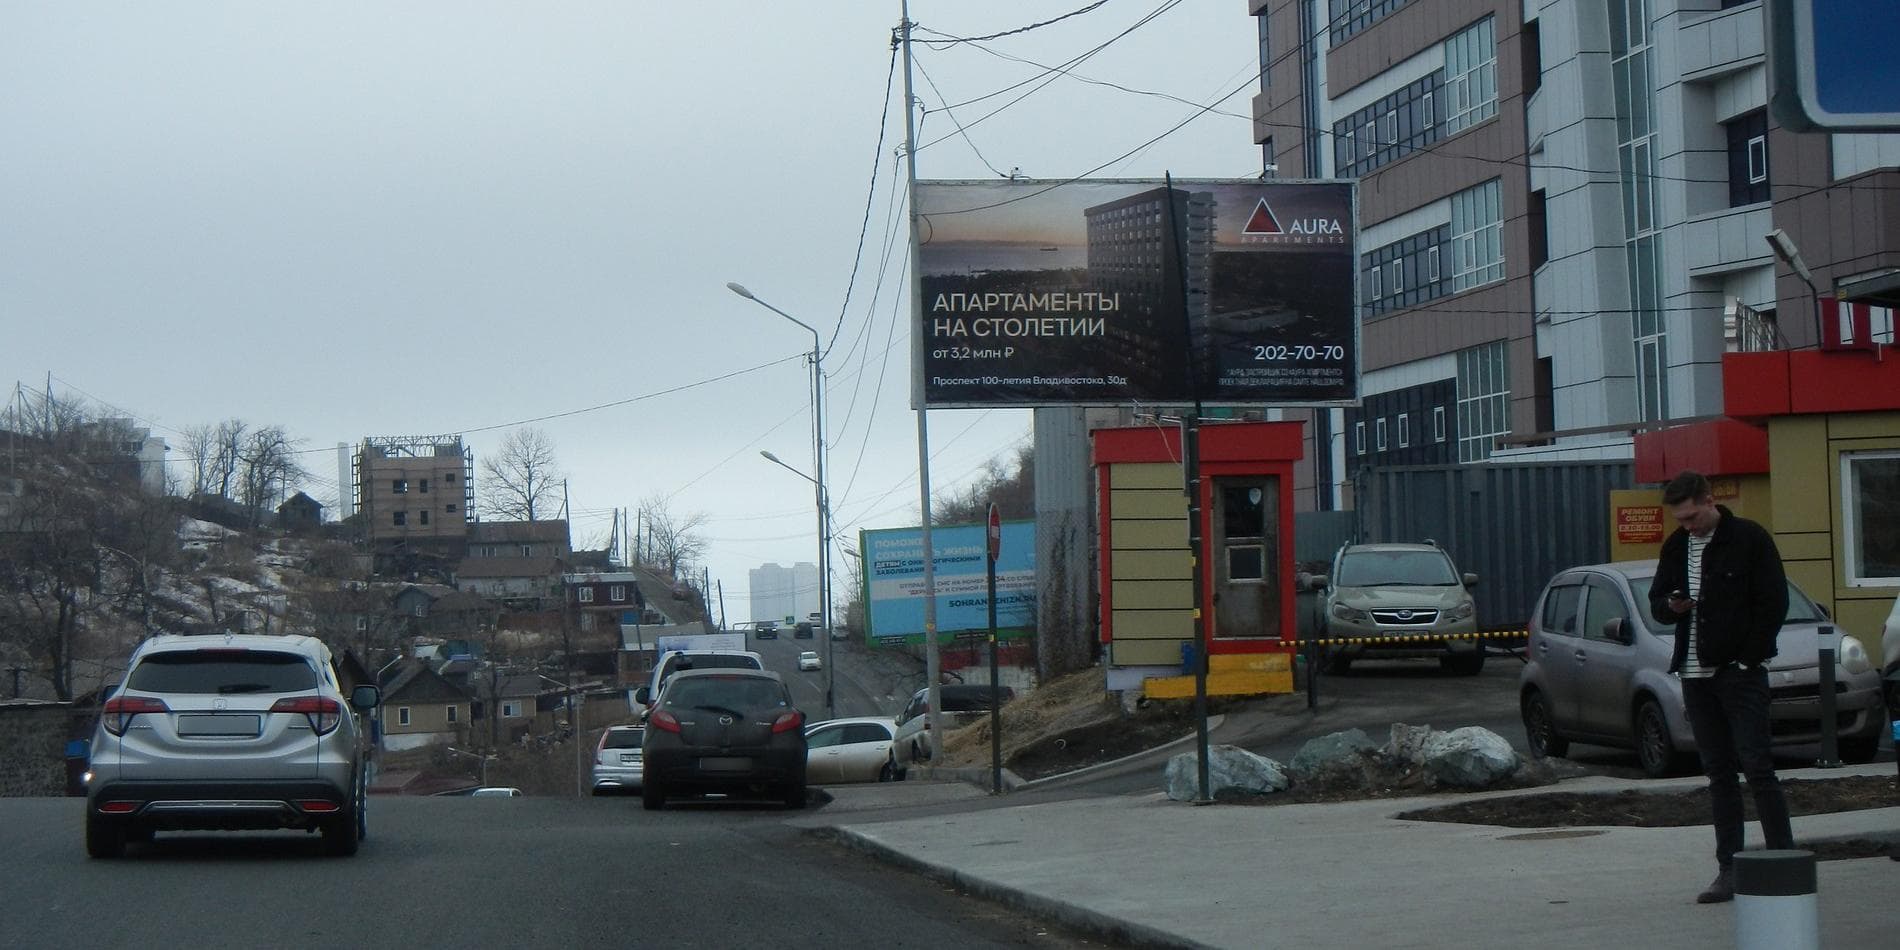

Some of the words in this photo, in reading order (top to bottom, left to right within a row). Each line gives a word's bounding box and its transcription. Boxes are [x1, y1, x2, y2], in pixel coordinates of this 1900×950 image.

[1289, 218, 1343, 234] AURA
[1240, 236, 1345, 244] APARTMENTS
[932, 292, 1120, 312] АПАРТАМЕНТЫ
[934, 318, 968, 337] НА
[972, 318, 1105, 337] СТОЛЕТИИ
[932, 349, 949, 359] от
[951, 347, 970, 361] 3,2
[973, 350, 1002, 359] млн
[1254, 345, 1344, 360] 202-70-70
[933, 376, 981, 387] Проспект
[981, 376, 1032, 386] 100-летия
[1033, 376, 1106, 387] Владивостока,
